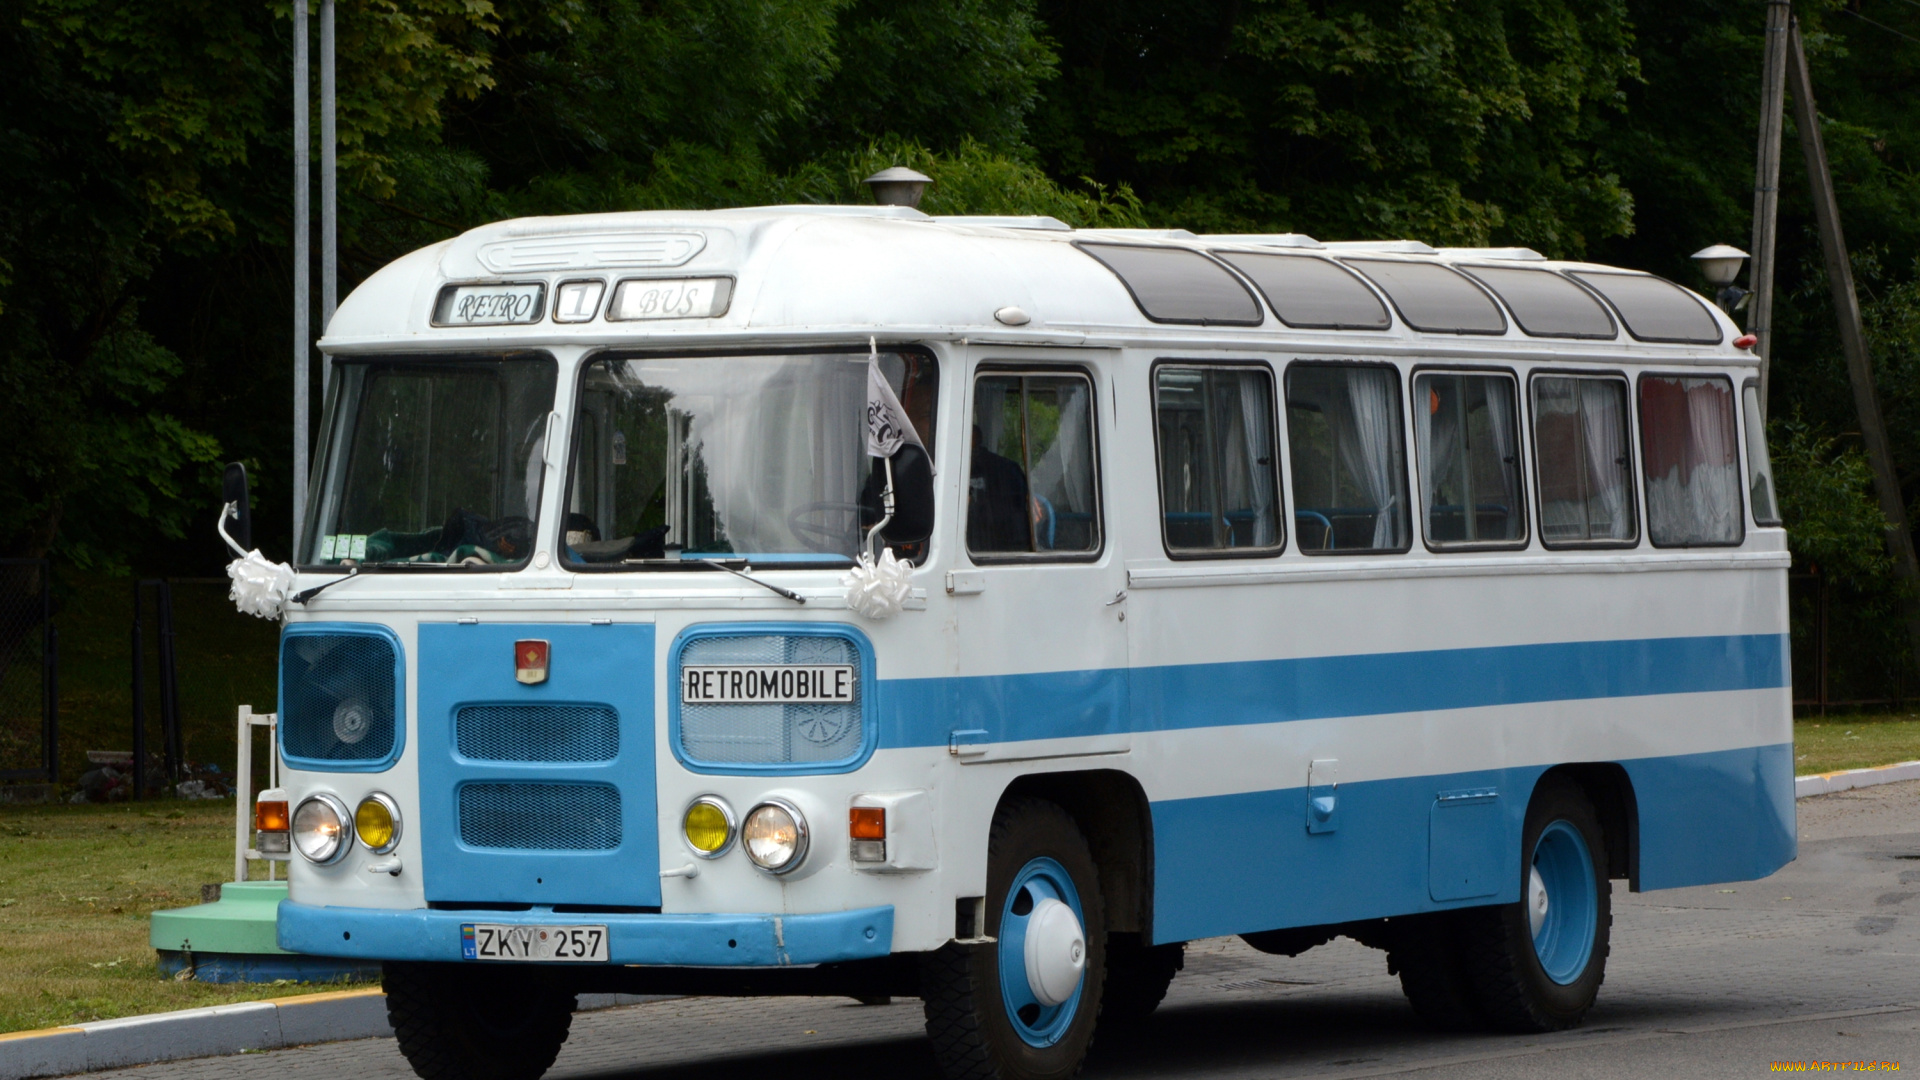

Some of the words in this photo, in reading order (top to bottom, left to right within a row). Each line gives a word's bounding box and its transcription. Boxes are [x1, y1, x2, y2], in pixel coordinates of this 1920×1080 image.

[457, 292, 530, 321] RETRO
[564, 286, 590, 316] 1
[639, 286, 700, 315] BUS
[687, 669, 848, 699] RETROMOBILE
[464, 948, 476, 956] LT
[479, 929, 532, 957] ZKY
[555, 930, 602, 957] 257
